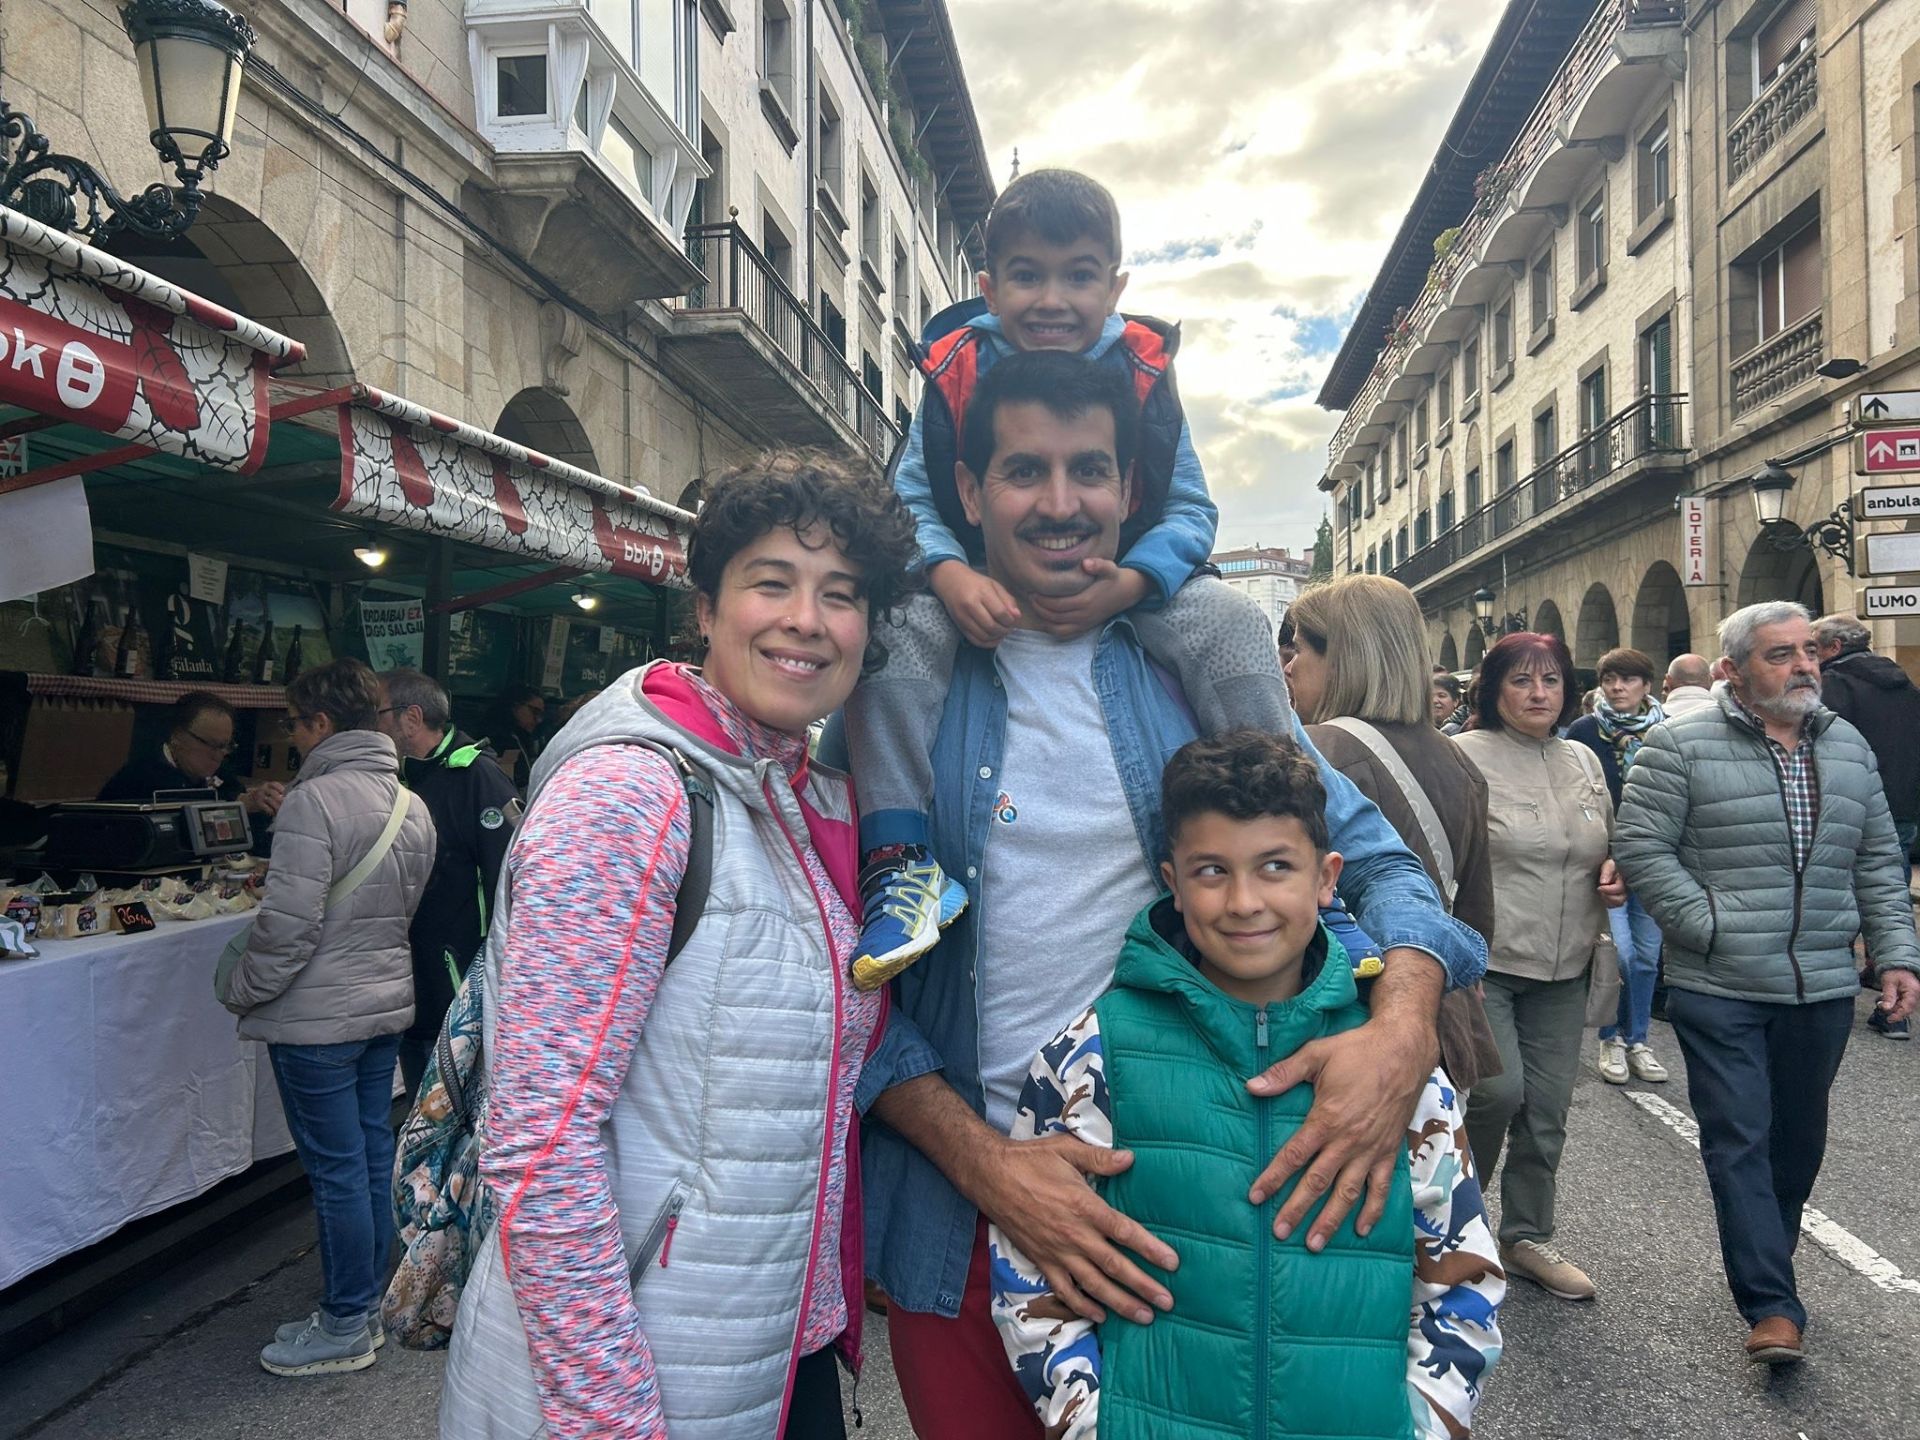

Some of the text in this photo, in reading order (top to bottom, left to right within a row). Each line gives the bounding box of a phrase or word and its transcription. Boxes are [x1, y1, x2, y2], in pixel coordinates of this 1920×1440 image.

[1690, 501, 1702, 581] LOTERIA
[624, 540, 650, 566] bbk
[1869, 595, 1917, 608] LUMO
[408, 607, 422, 620] EZ
